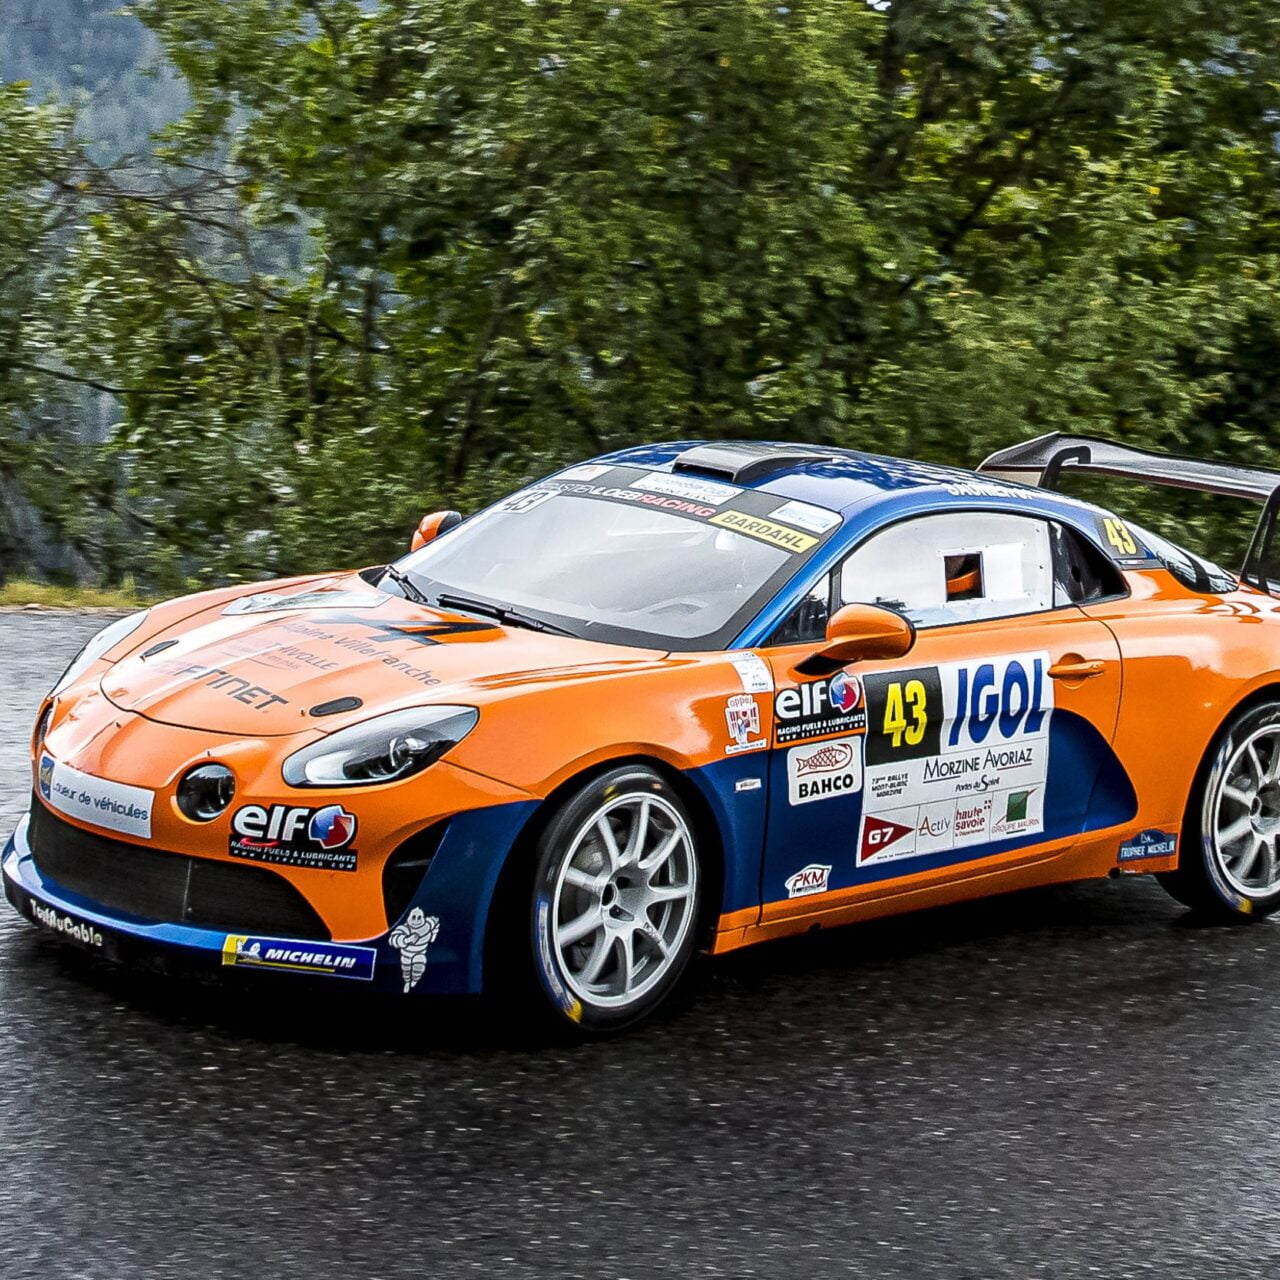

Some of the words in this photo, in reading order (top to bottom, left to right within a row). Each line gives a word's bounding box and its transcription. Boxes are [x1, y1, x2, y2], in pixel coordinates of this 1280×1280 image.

[720, 512, 803, 549] BARDAHL
[1103, 518, 1137, 555] 43
[334, 636, 443, 687] Villefranche
[775, 681, 827, 719] elf
[883, 680, 928, 748] 43
[948, 658, 1047, 747] IGOL
[923, 756, 980, 781] MORZINE
[982, 748, 1033, 773] AVORIAZ
[799, 773, 854, 799] BAHCO
[78, 791, 91, 806] de
[94, 797, 149, 821] véhicules
[955, 806, 983, 820] haute
[233, 805, 310, 841] elf
[868, 826, 894, 846] G7
[955, 817, 986, 831] savoie
[793, 868, 825, 888] PKM
[265, 948, 358, 969] MICHELIN
